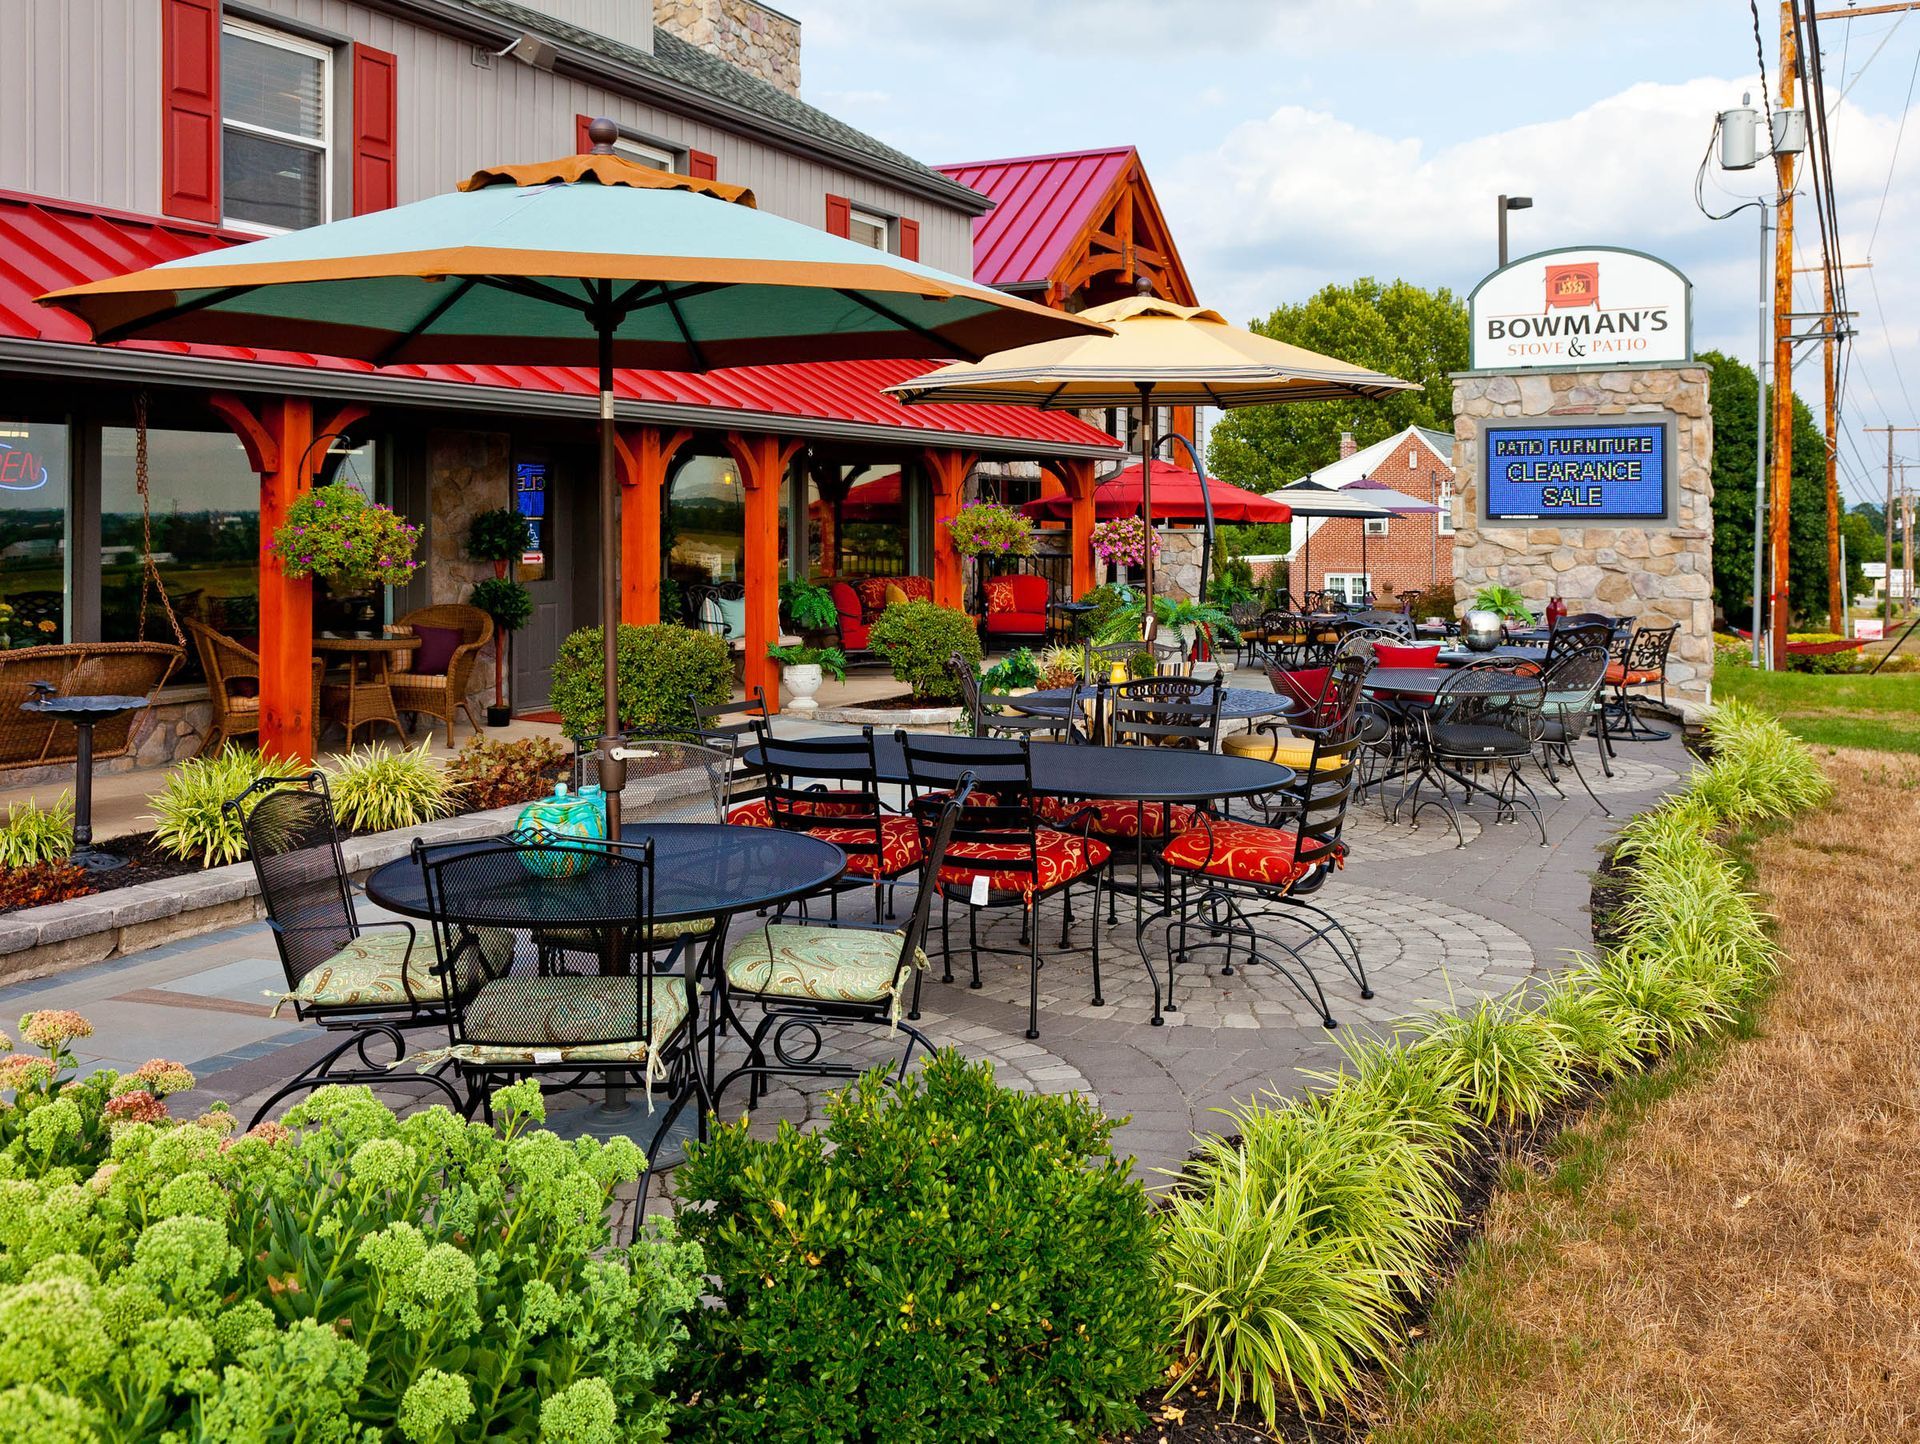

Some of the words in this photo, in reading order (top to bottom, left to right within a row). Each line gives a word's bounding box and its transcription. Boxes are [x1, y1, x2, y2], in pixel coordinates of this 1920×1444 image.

[1488, 310, 1668, 340] BOWMAN'S
[1507, 340, 1564, 356] STOVE
[1568, 337, 1586, 357] &
[1592, 337, 1647, 353] PATIO
[1497, 440, 1543, 455] PATIO
[1550, 438, 1652, 454] FURNITURE
[0, 451, 43, 482] EN
[1507, 462, 1641, 481] CLEARANCE
[1543, 487, 1602, 507] SALE
